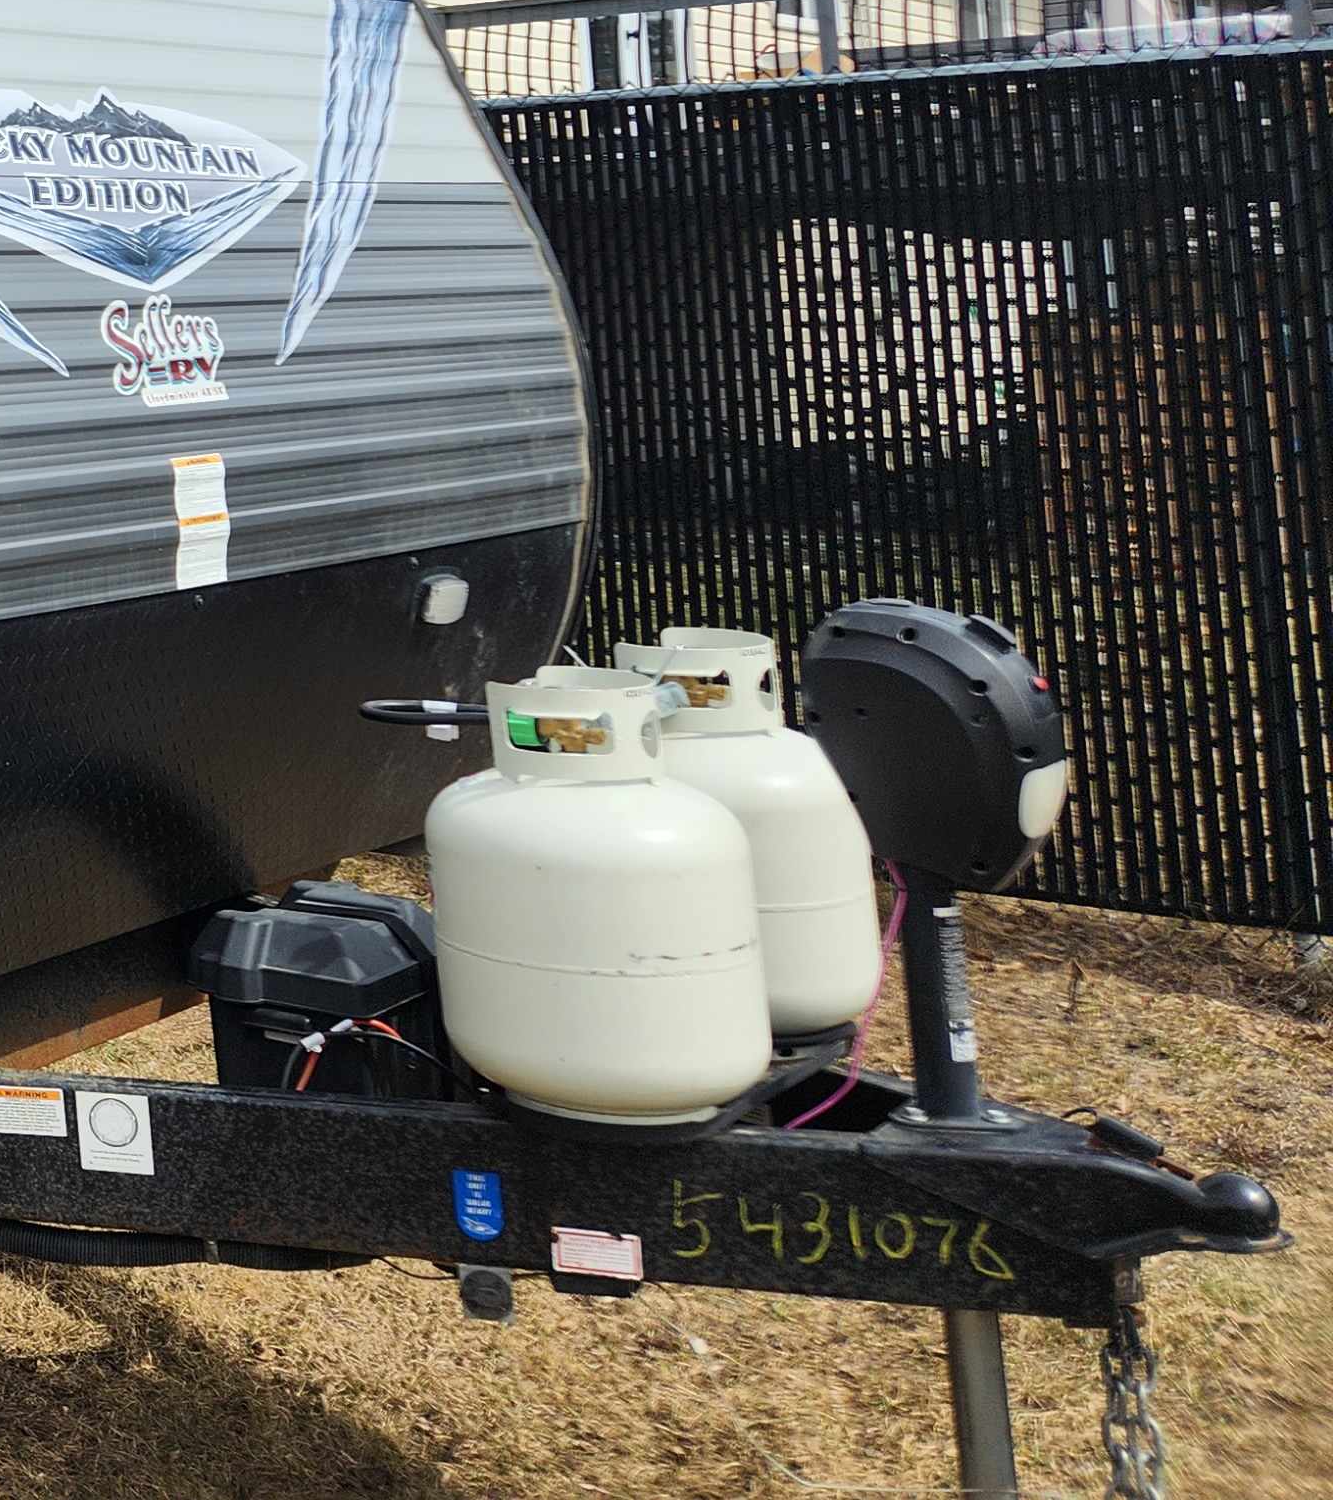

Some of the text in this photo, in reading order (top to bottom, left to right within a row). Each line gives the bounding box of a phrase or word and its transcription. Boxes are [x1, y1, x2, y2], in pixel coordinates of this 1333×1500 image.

[65, 132, 263, 177] MOUNTAIN
[28, 176, 189, 213] EDITION
[106, 300, 221, 392] Sellers
[169, 354, 217, 385] RV
[4, 1090, 48, 1099] WARNING
[672, 1179, 1016, 1281] 5431076
